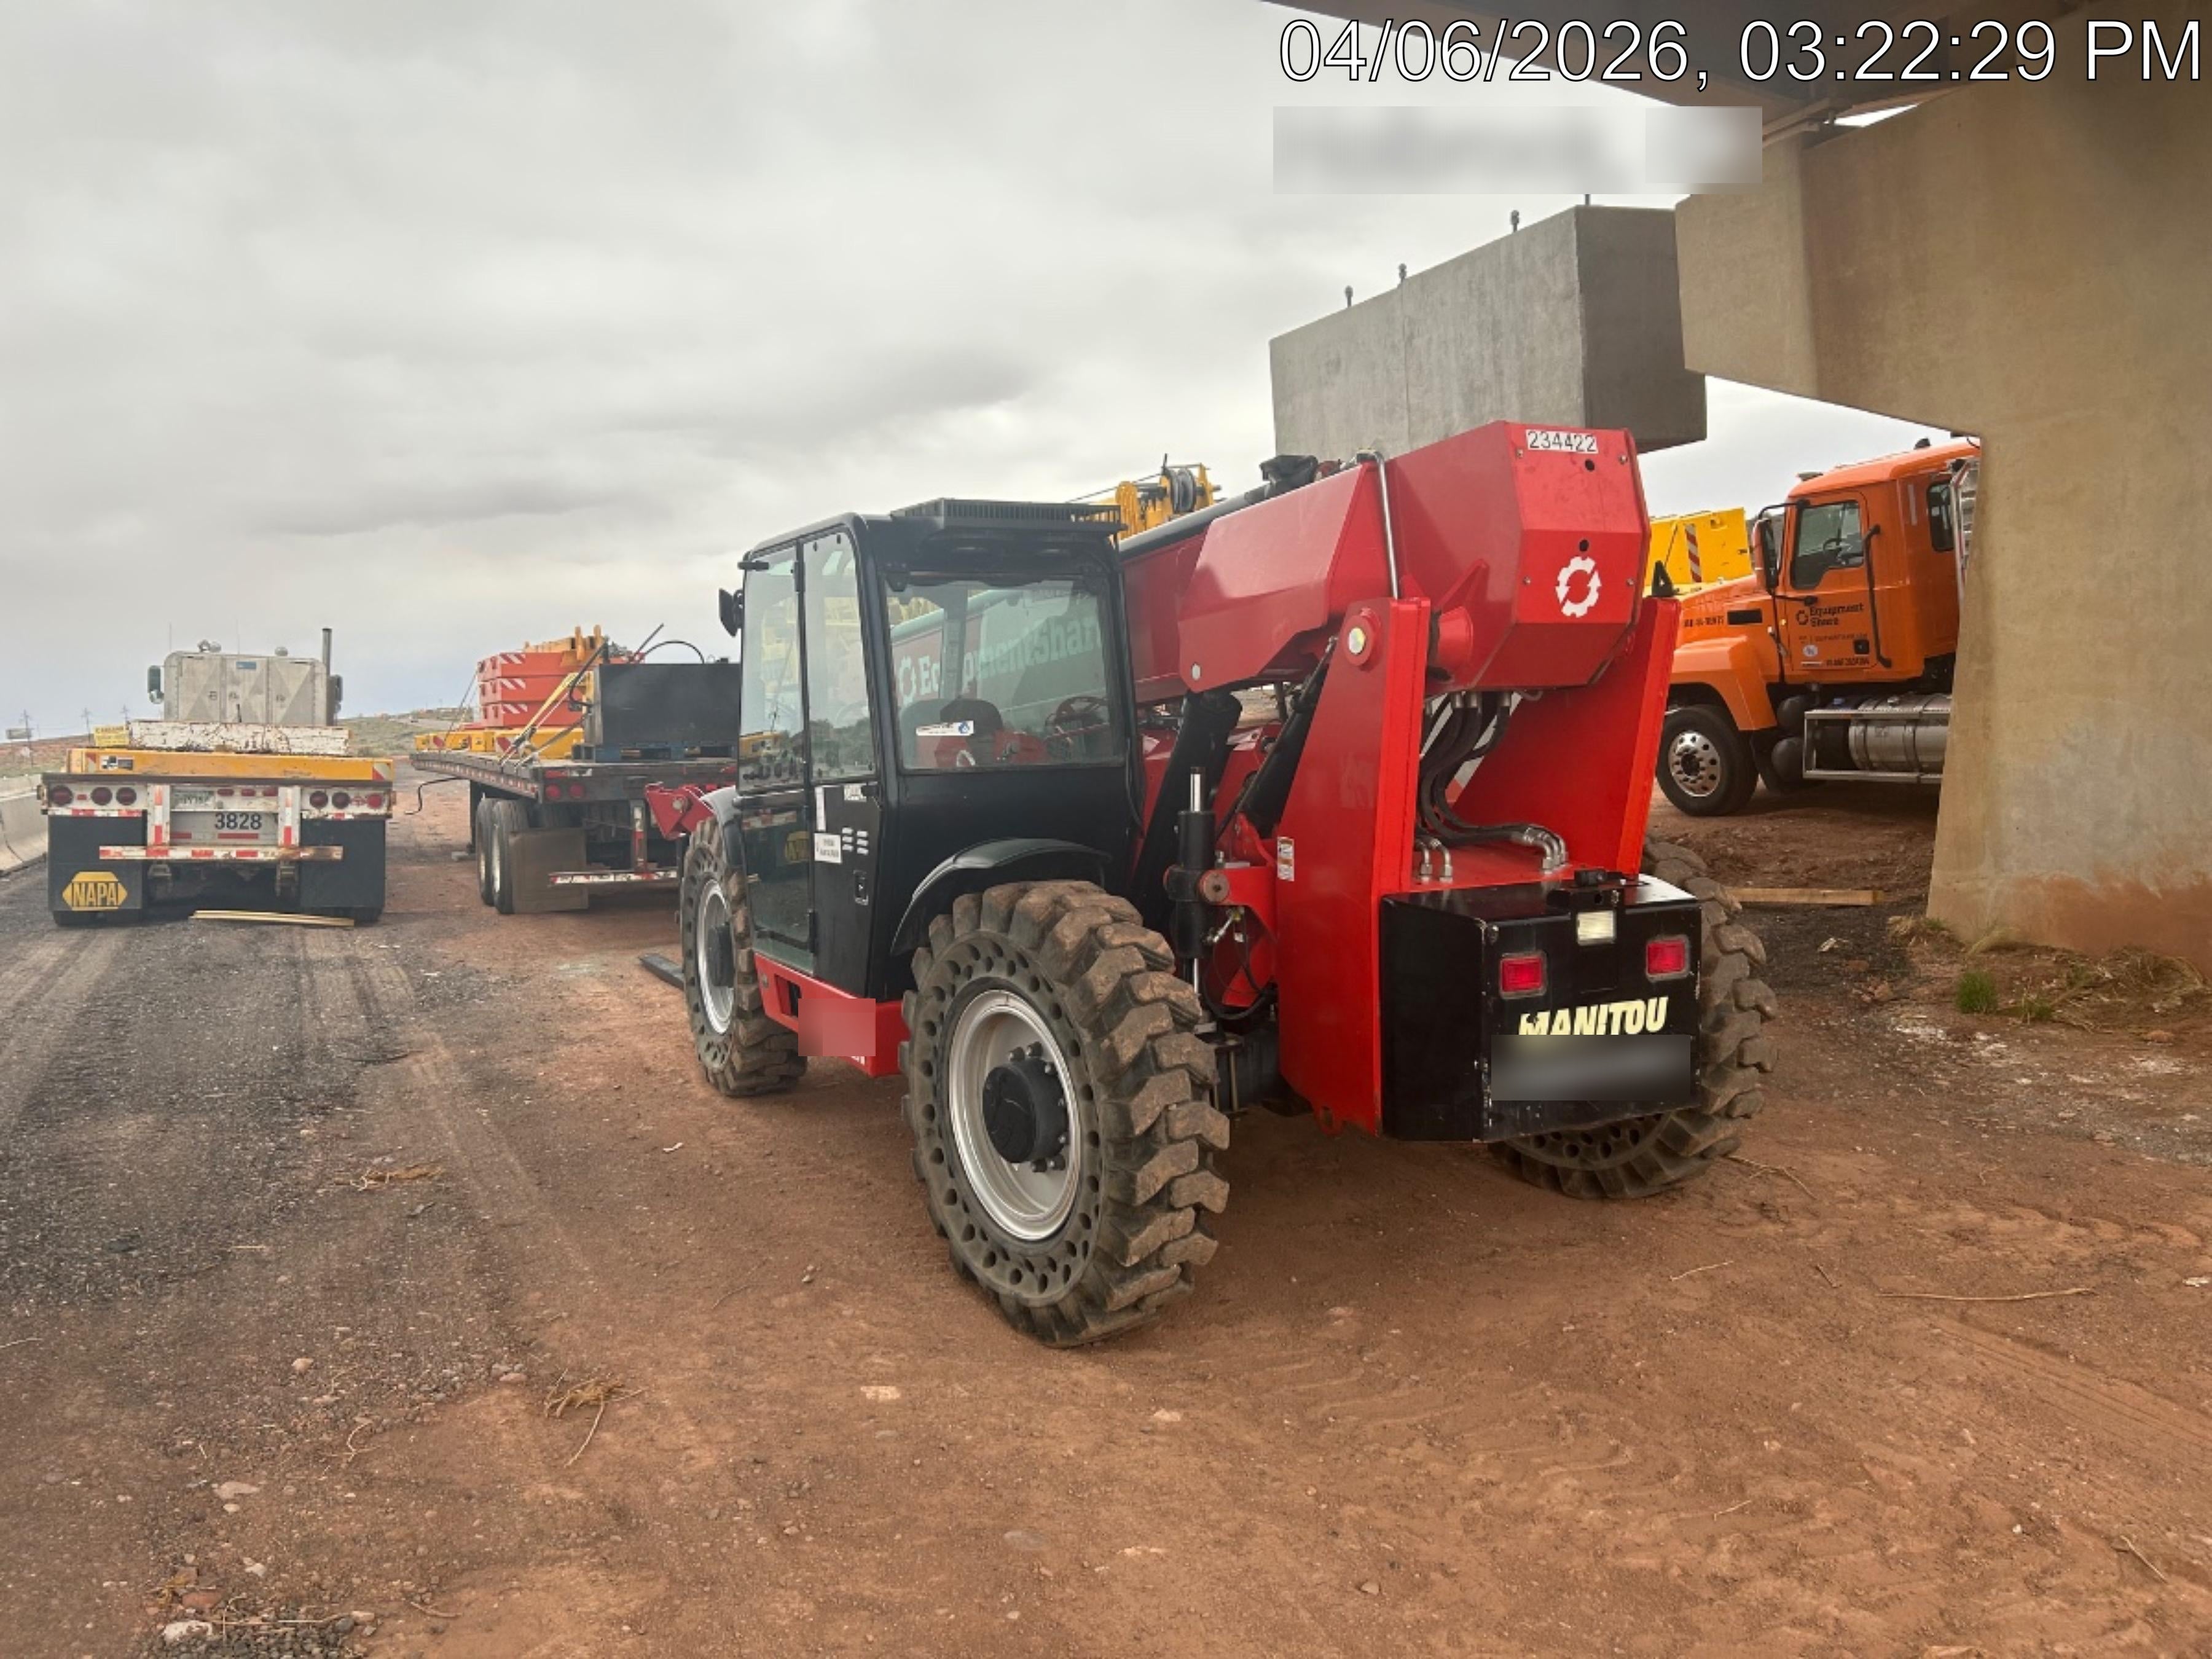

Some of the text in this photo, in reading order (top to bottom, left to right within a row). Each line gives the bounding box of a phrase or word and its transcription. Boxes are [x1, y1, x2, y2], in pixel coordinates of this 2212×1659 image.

[1528, 431, 1596, 452] 234422
[214, 812, 262, 830] 3828
[72, 882, 118, 907] NAPA
[1518, 996, 1669, 1035] MANITOU
